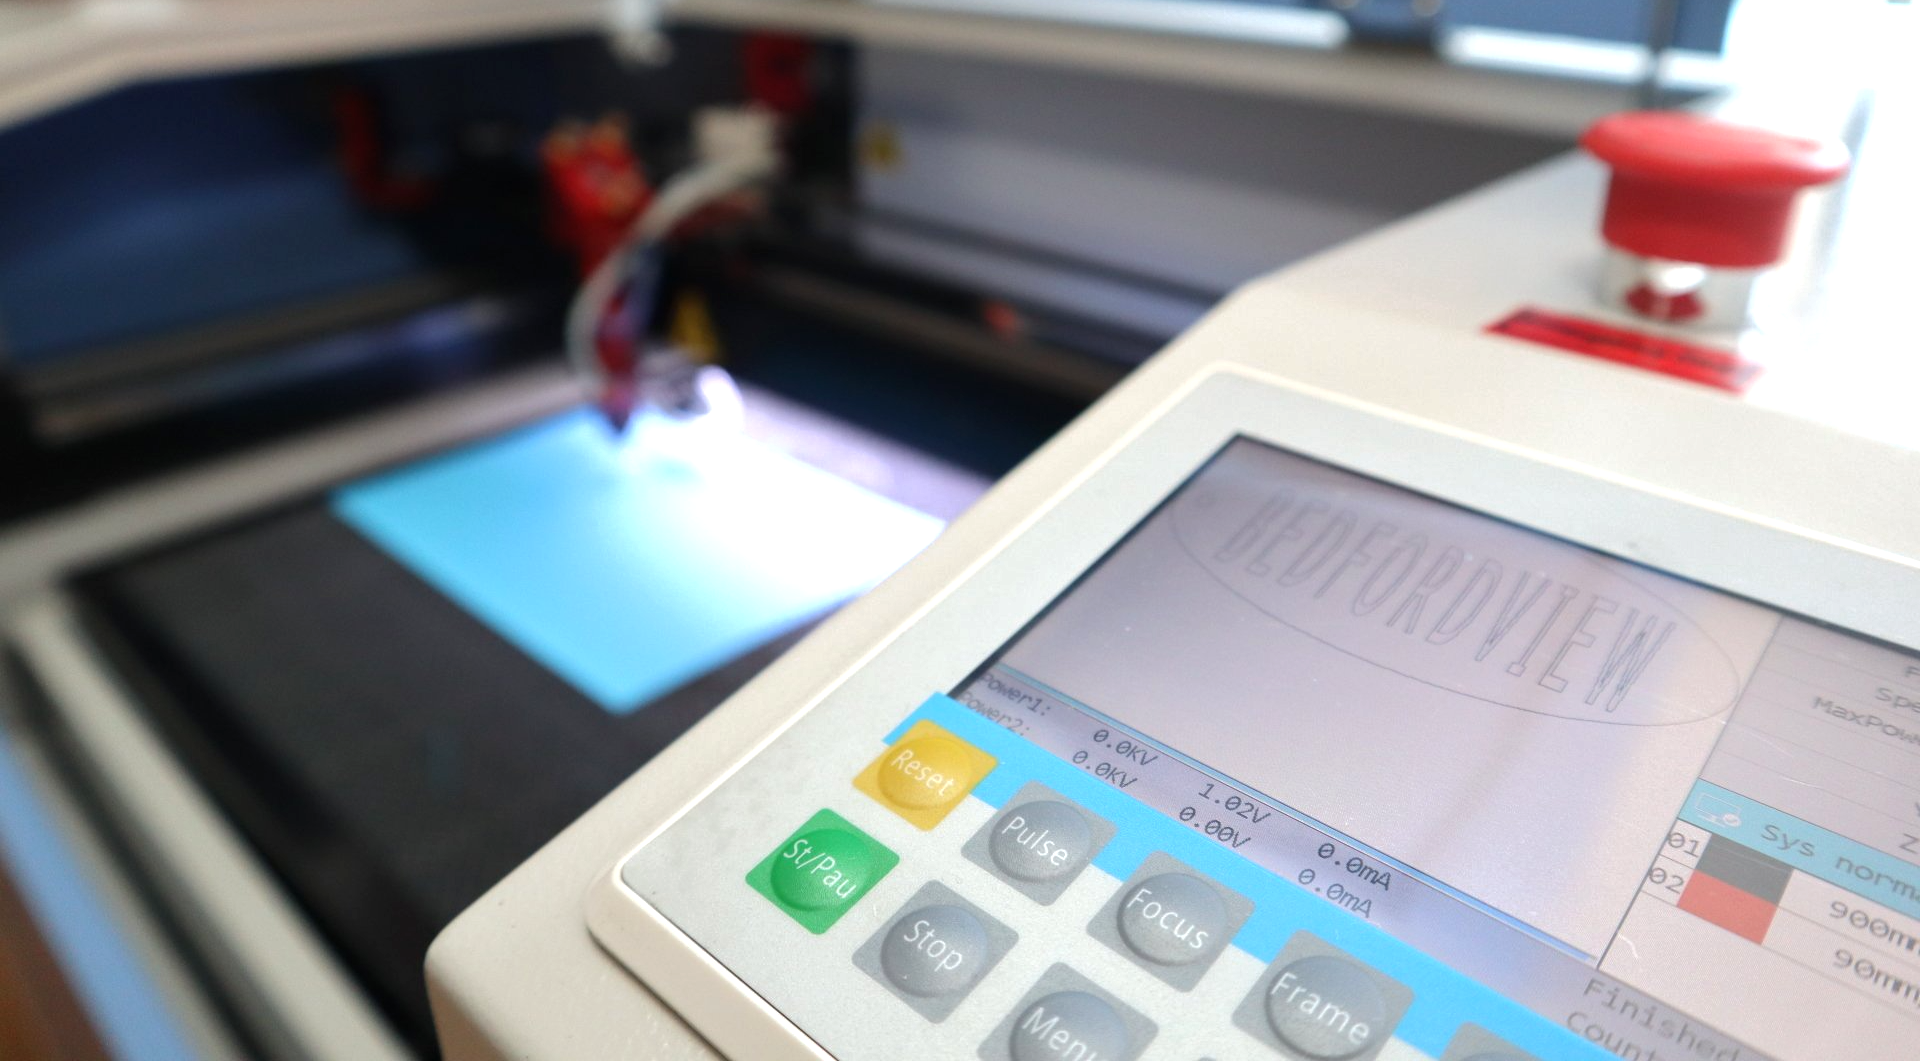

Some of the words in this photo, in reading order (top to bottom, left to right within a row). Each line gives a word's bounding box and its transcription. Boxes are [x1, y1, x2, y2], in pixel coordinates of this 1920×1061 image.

[1212, 487, 1679, 713] BEDFORDVIEW
[890, 748, 956, 797] Reset
[979, 673, 1052, 717] Power1:
[1092, 728, 1159, 767] 0.0KV
[1198, 782, 1272, 824] 1.02V
[1317, 842, 1392, 892] 0.0mA
[1001, 815, 1069, 867] Pulse
[1071, 750, 1138, 789] 0.0KV
[1178, 806, 1251, 849] 0.00V
[1297, 868, 1373, 919] 0.0mA
[1667, 832, 1700, 858] 01
[1760, 824, 1816, 858] Sys
[782, 838, 858, 900] St/Pau
[902, 919, 964, 973] Stop
[1125, 887, 1210, 950] Focus
[1648, 867, 1685, 895] 02
[1833, 949, 1920, 1010] 90mm
[1269, 971, 1371, 1046] Frame
